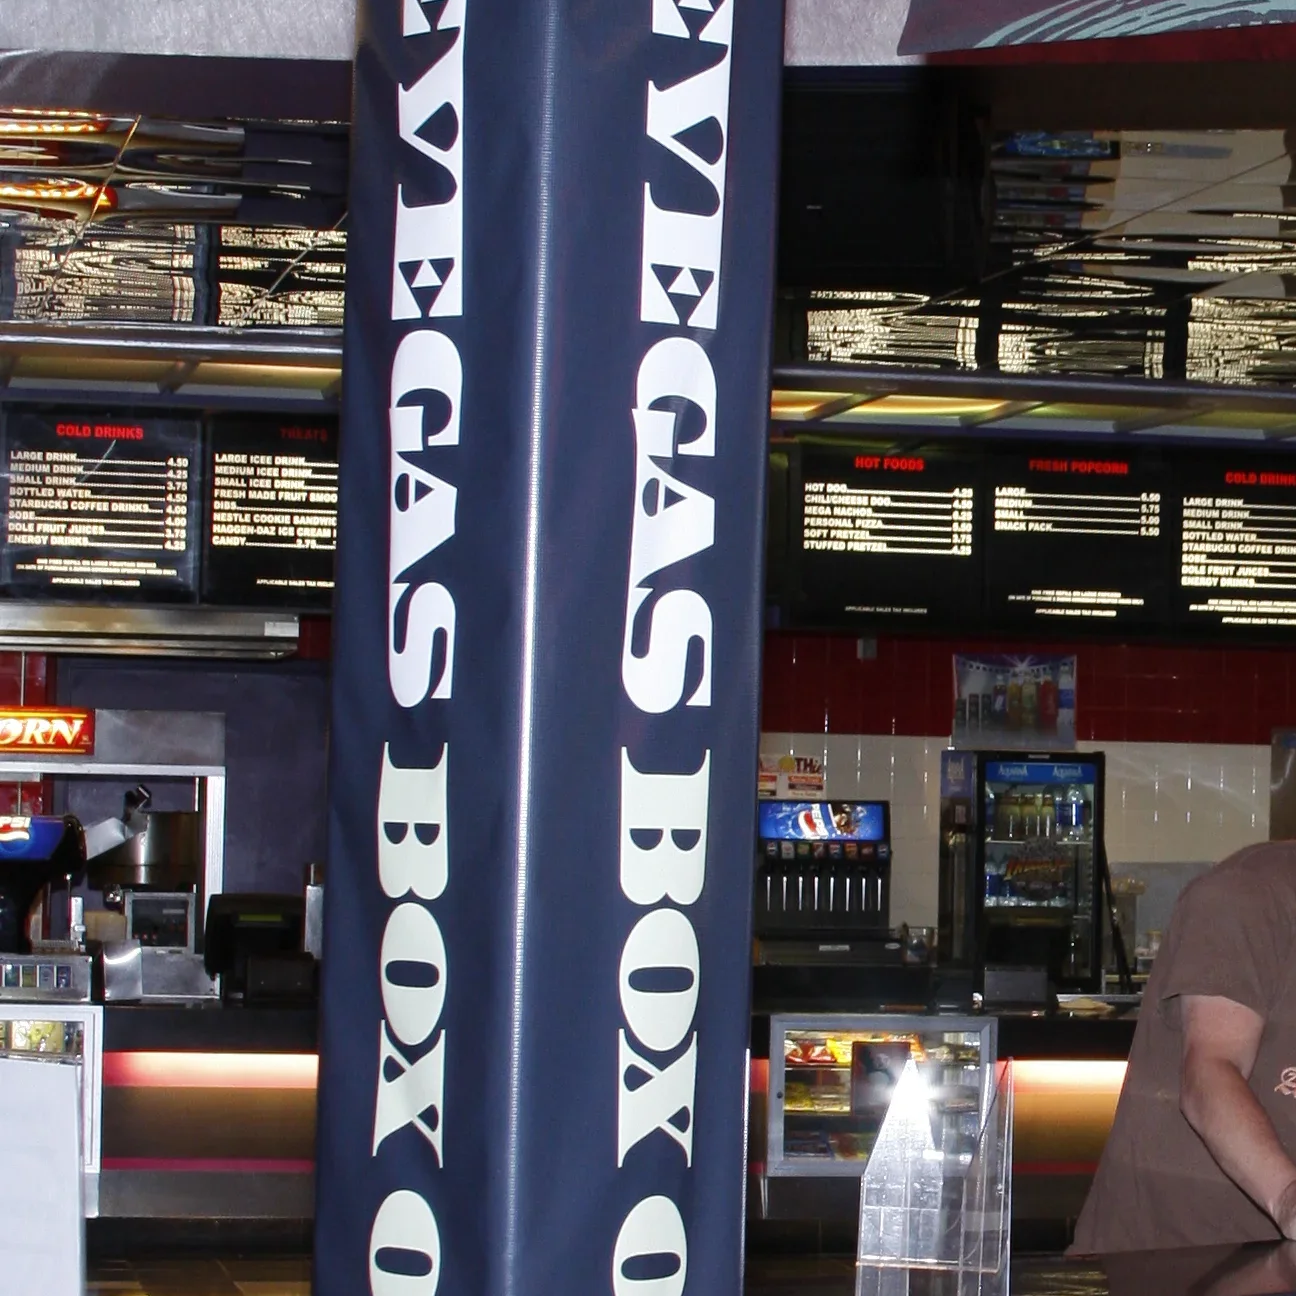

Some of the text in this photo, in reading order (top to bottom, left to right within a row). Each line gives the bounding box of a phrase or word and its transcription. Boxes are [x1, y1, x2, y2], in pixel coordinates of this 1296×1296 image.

[56, 424, 143, 440] COLD DRINKS
[10, 451, 188, 468] LARGE DRINK 4.50
[215, 453, 305, 466] LARGE ICEE DRINK
[855, 456, 924, 471] HOT FOODS
[10, 463, 188, 479] MEDIUM DRINK 4.25
[215, 465, 312, 478] MEDIUM ICEE DRINK
[1029, 459, 1128, 474] FRESH POPCORN
[9, 476, 187, 491] SMALL DRINK 3.75
[214, 477, 305, 489] SMALL ICEE DRINK
[1225, 471, 1257, 484] COLD
[805, 483, 825, 492] HOT
[827, 484, 847, 493] DOG
[995, 486, 1026, 496] LARGE
[9, 487, 187, 503] BOTTLED WATER 4.50
[214, 489, 338, 503] FRESH MADE FRUIT SMOO
[9, 499, 187, 515] STARBUCKS COFFEE DRINKS 4.00
[214, 501, 237, 510] DIBS
[870, 497, 891, 507] DOG
[995, 498, 1032, 508] MEDIUM
[1183, 497, 1213, 506] LARGE
[1215, 498, 1243, 508] DRINK
[8, 511, 35, 520] SOBE
[805, 506, 831, 516] MEGA
[833, 507, 872, 517] NACHOS
[995, 509, 1024, 519] SMALL
[1183, 509, 1219, 518] MEDIUM
[1222, 510, 1250, 519] DRINK
[213, 513, 337, 526] NESTLE COOKIE SANDWIC
[804, 517, 853, 527] PERSONAL
[856, 519, 883, 529] PIZZA
[1183, 520, 1212, 529] SMALL
[1215, 521, 1243, 530] DRINK
[8, 523, 186, 539] DOLE FRUIT JUICES 3.75
[278, 526, 294, 536] ICE
[297, 528, 331, 537] CREAM
[995, 521, 1026, 531] SNACK
[1028, 522, 1053, 532] PACK
[804, 529, 828, 538] SOFT
[831, 530, 870, 540] PRETZEL
[1182, 531, 1223, 541] BOTTLED
[1226, 532, 1257, 542] WATER
[8, 535, 185, 551] ENERGY DRINKS 4.25
[212, 536, 246, 546] CANDY
[804, 541, 846, 551] STUFFED
[848, 542, 887, 552] PRETZEL
[1182, 542, 1236, 553] STARBUCKS
[1238, 544, 1272, 554] COFFEE
[372, 741, 448, 1169] BOX
[617, 746, 710, 1169] BOX
